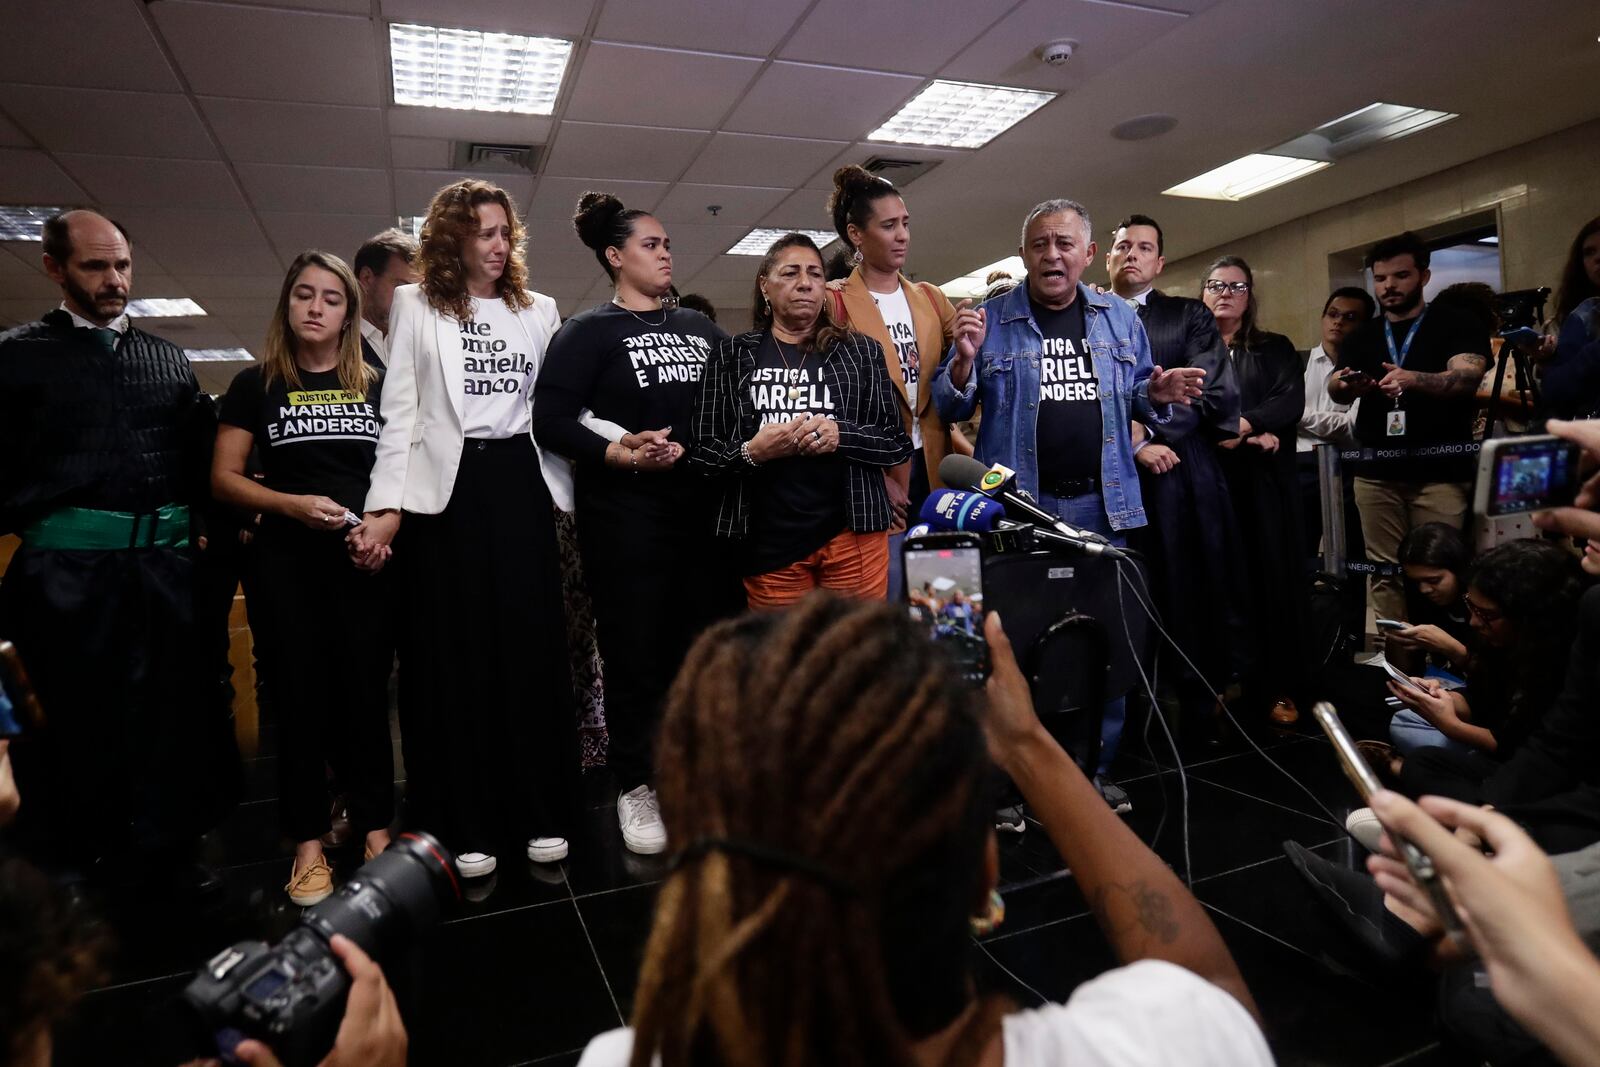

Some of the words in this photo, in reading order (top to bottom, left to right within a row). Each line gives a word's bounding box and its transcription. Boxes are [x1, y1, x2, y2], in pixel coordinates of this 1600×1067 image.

[1043, 337, 1076, 356] TIÇA
[464, 353, 533, 376] arielle
[1041, 356, 1092, 383] RIEL
[635, 369, 649, 388] E
[751, 368, 810, 384] USTIÇA
[464, 378, 521, 395] anco.
[1040, 382, 1097, 401] NDERS
[296, 393, 337, 403] JUSTIÇA
[280, 404, 375, 419] MARIELLE
[267, 423, 280, 440] E
[1465, 443, 1480, 453] DO
[945, 492, 966, 520] RTP
